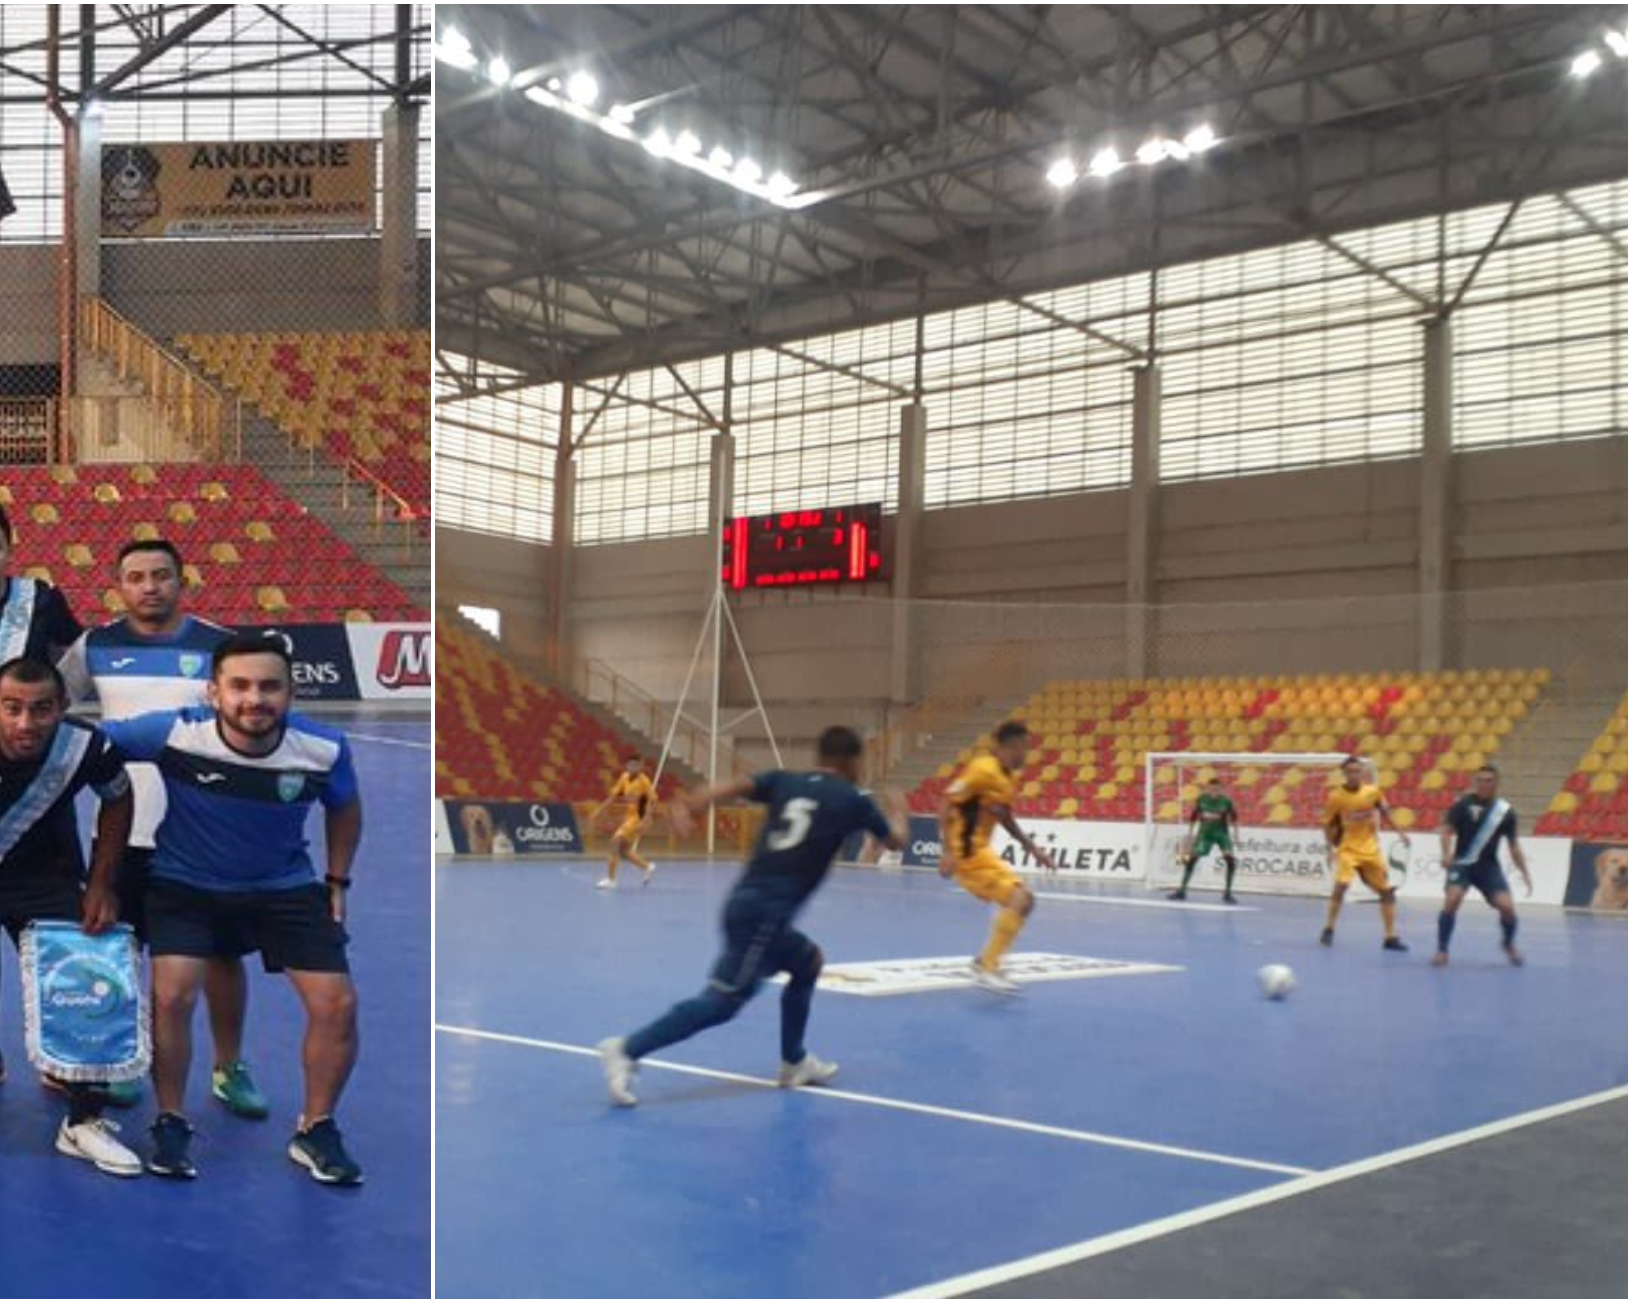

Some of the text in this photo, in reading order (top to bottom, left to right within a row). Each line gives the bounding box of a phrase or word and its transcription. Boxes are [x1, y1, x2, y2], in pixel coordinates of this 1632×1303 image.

[188, 143, 350, 169] ANUNCIE
[226, 174, 312, 200] AQUI
[515, 826, 574, 842] ORIGENS
[768, 797, 819, 851] 5
